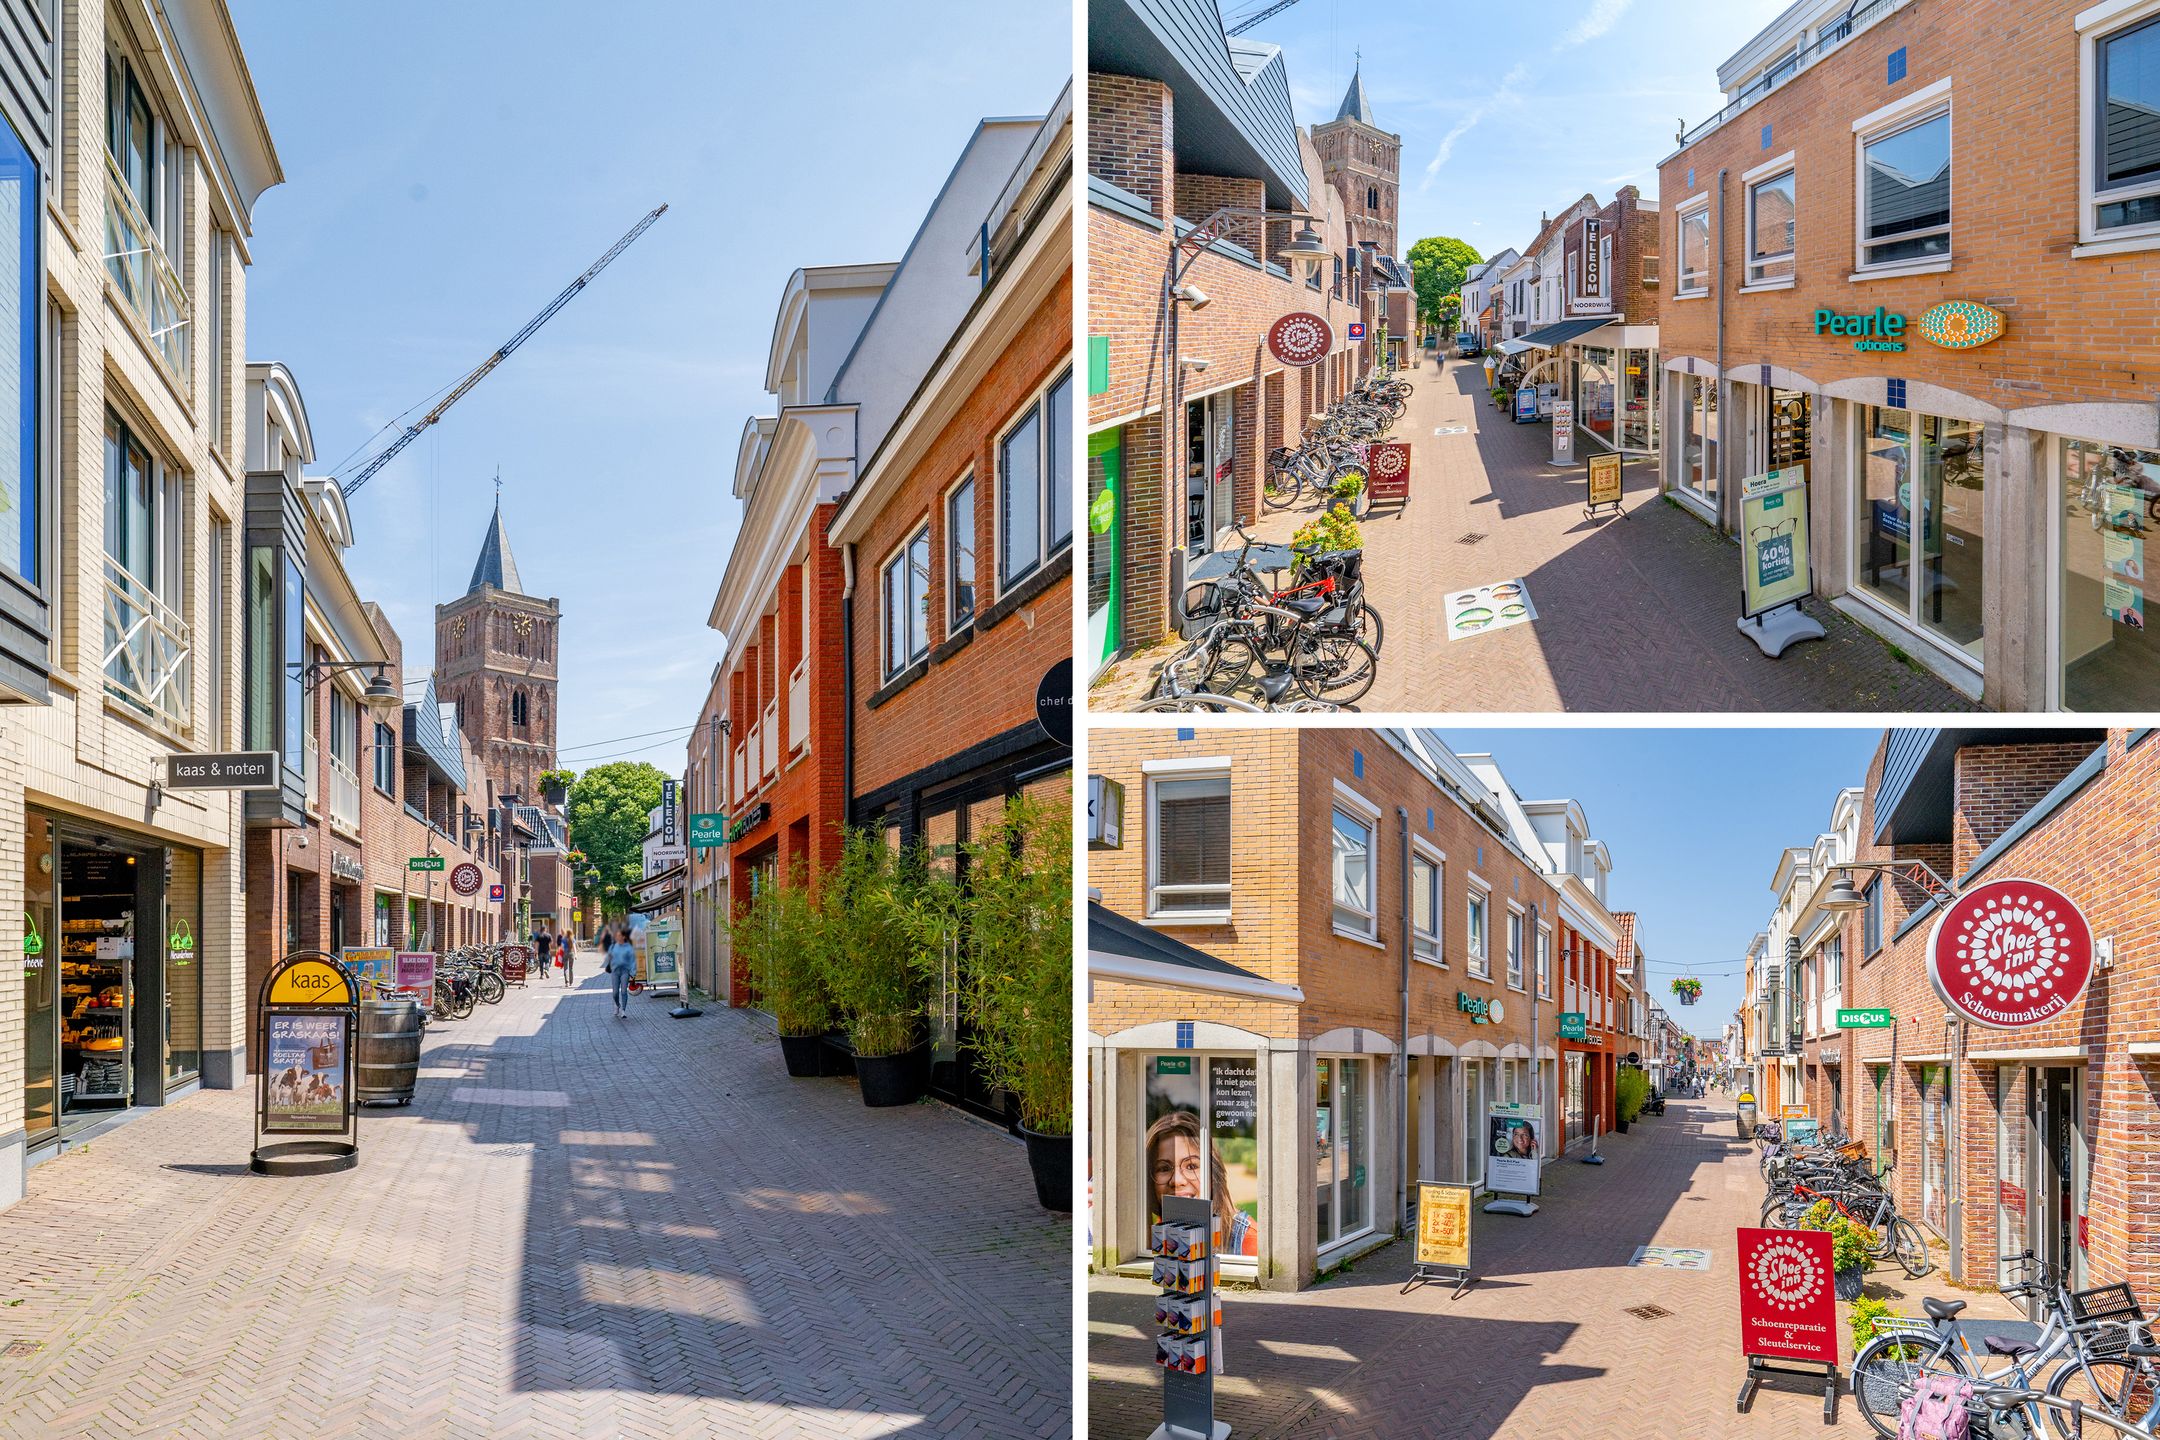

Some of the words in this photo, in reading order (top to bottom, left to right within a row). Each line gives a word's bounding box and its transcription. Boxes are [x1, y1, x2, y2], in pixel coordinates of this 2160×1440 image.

[1588, 222, 1597, 293] TELECOM
[1815, 306, 1906, 337] Pearle
[1854, 339, 1907, 353] opticiens
[1278, 352, 1323, 366] Schoenmakerij
[1750, 479, 1767, 488] Hoera
[1761, 544, 1790, 562] 40%
[1762, 555, 1791, 571] korting
[1040, 696, 1064, 706] chef
[176, 763, 205, 776] kaas
[211, 762, 221, 776] &
[226, 764, 264, 775] noten
[665, 783, 674, 843] TELECOM
[691, 830, 721, 839] Pearle
[412, 861, 441, 869] DISCUS
[1989, 926, 2038, 960] Shoe
[2004, 949, 2035, 971] inn
[291, 969, 330, 989] kaas
[1458, 992, 1488, 1016] Pearle
[1959, 992, 2067, 1022] Schoenmakerij
[274, 1021, 289, 1029] ER
[292, 1021, 303, 1030] IS
[305, 1022, 337, 1030] WEER
[1841, 1012, 1885, 1025] DISCUS
[272, 1031, 340, 1040] GRASKAAS!
[1224, 1067, 1244, 1076] dacht
[1224, 1078, 1238, 1086] niet
[1231, 1089, 1253, 1098] lezen,
[1235, 1101, 1249, 1109] zag
[1769, 1258, 1801, 1281] Shoe
[1781, 1274, 1801, 1289] inn
[1751, 1317, 1826, 1333] Schoenreparatie
[1784, 1331, 1794, 1339] &
[1758, 1337, 1821, 1351] Sleutelservice
